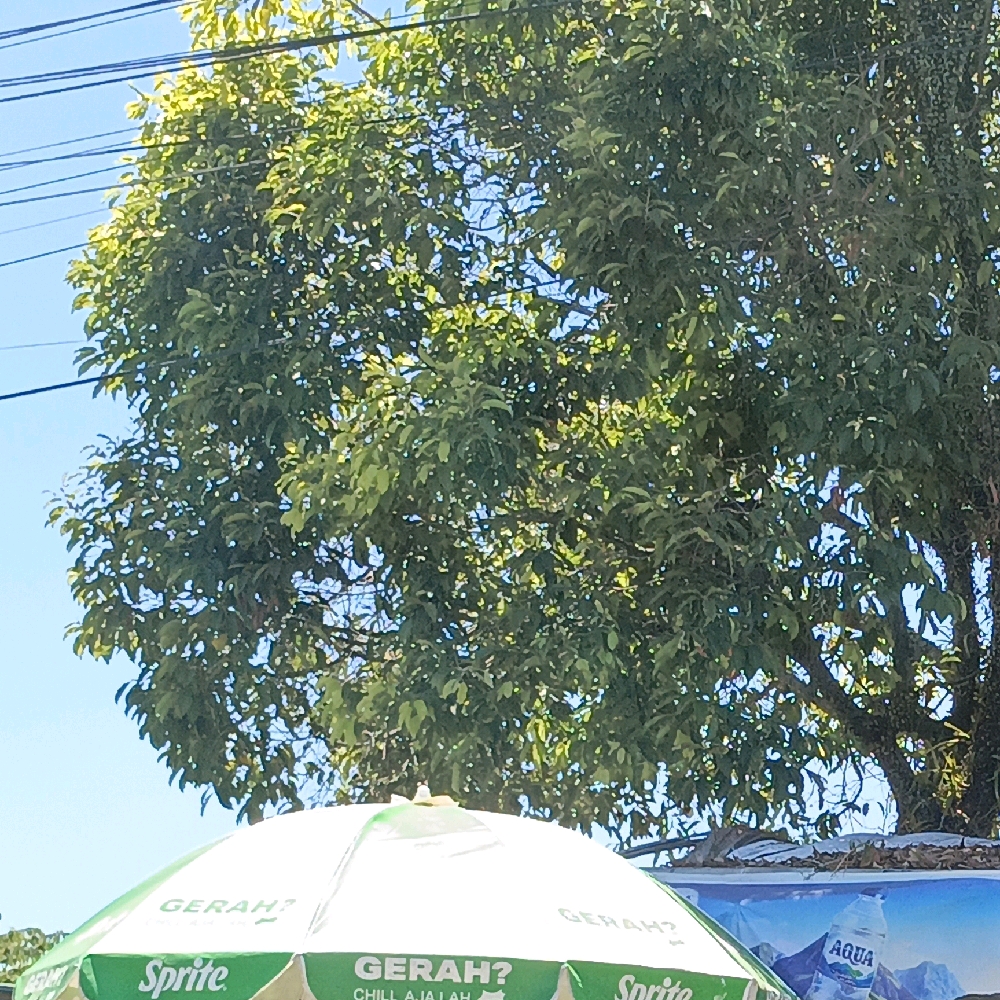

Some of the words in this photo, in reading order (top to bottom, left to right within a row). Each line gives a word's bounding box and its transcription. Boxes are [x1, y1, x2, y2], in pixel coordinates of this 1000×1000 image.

[159, 899, 296, 913] GERAH?
[828, 939, 874, 967] AQUA
[138, 957, 229, 999] Sprite
[354, 956, 513, 985] GERAH?
